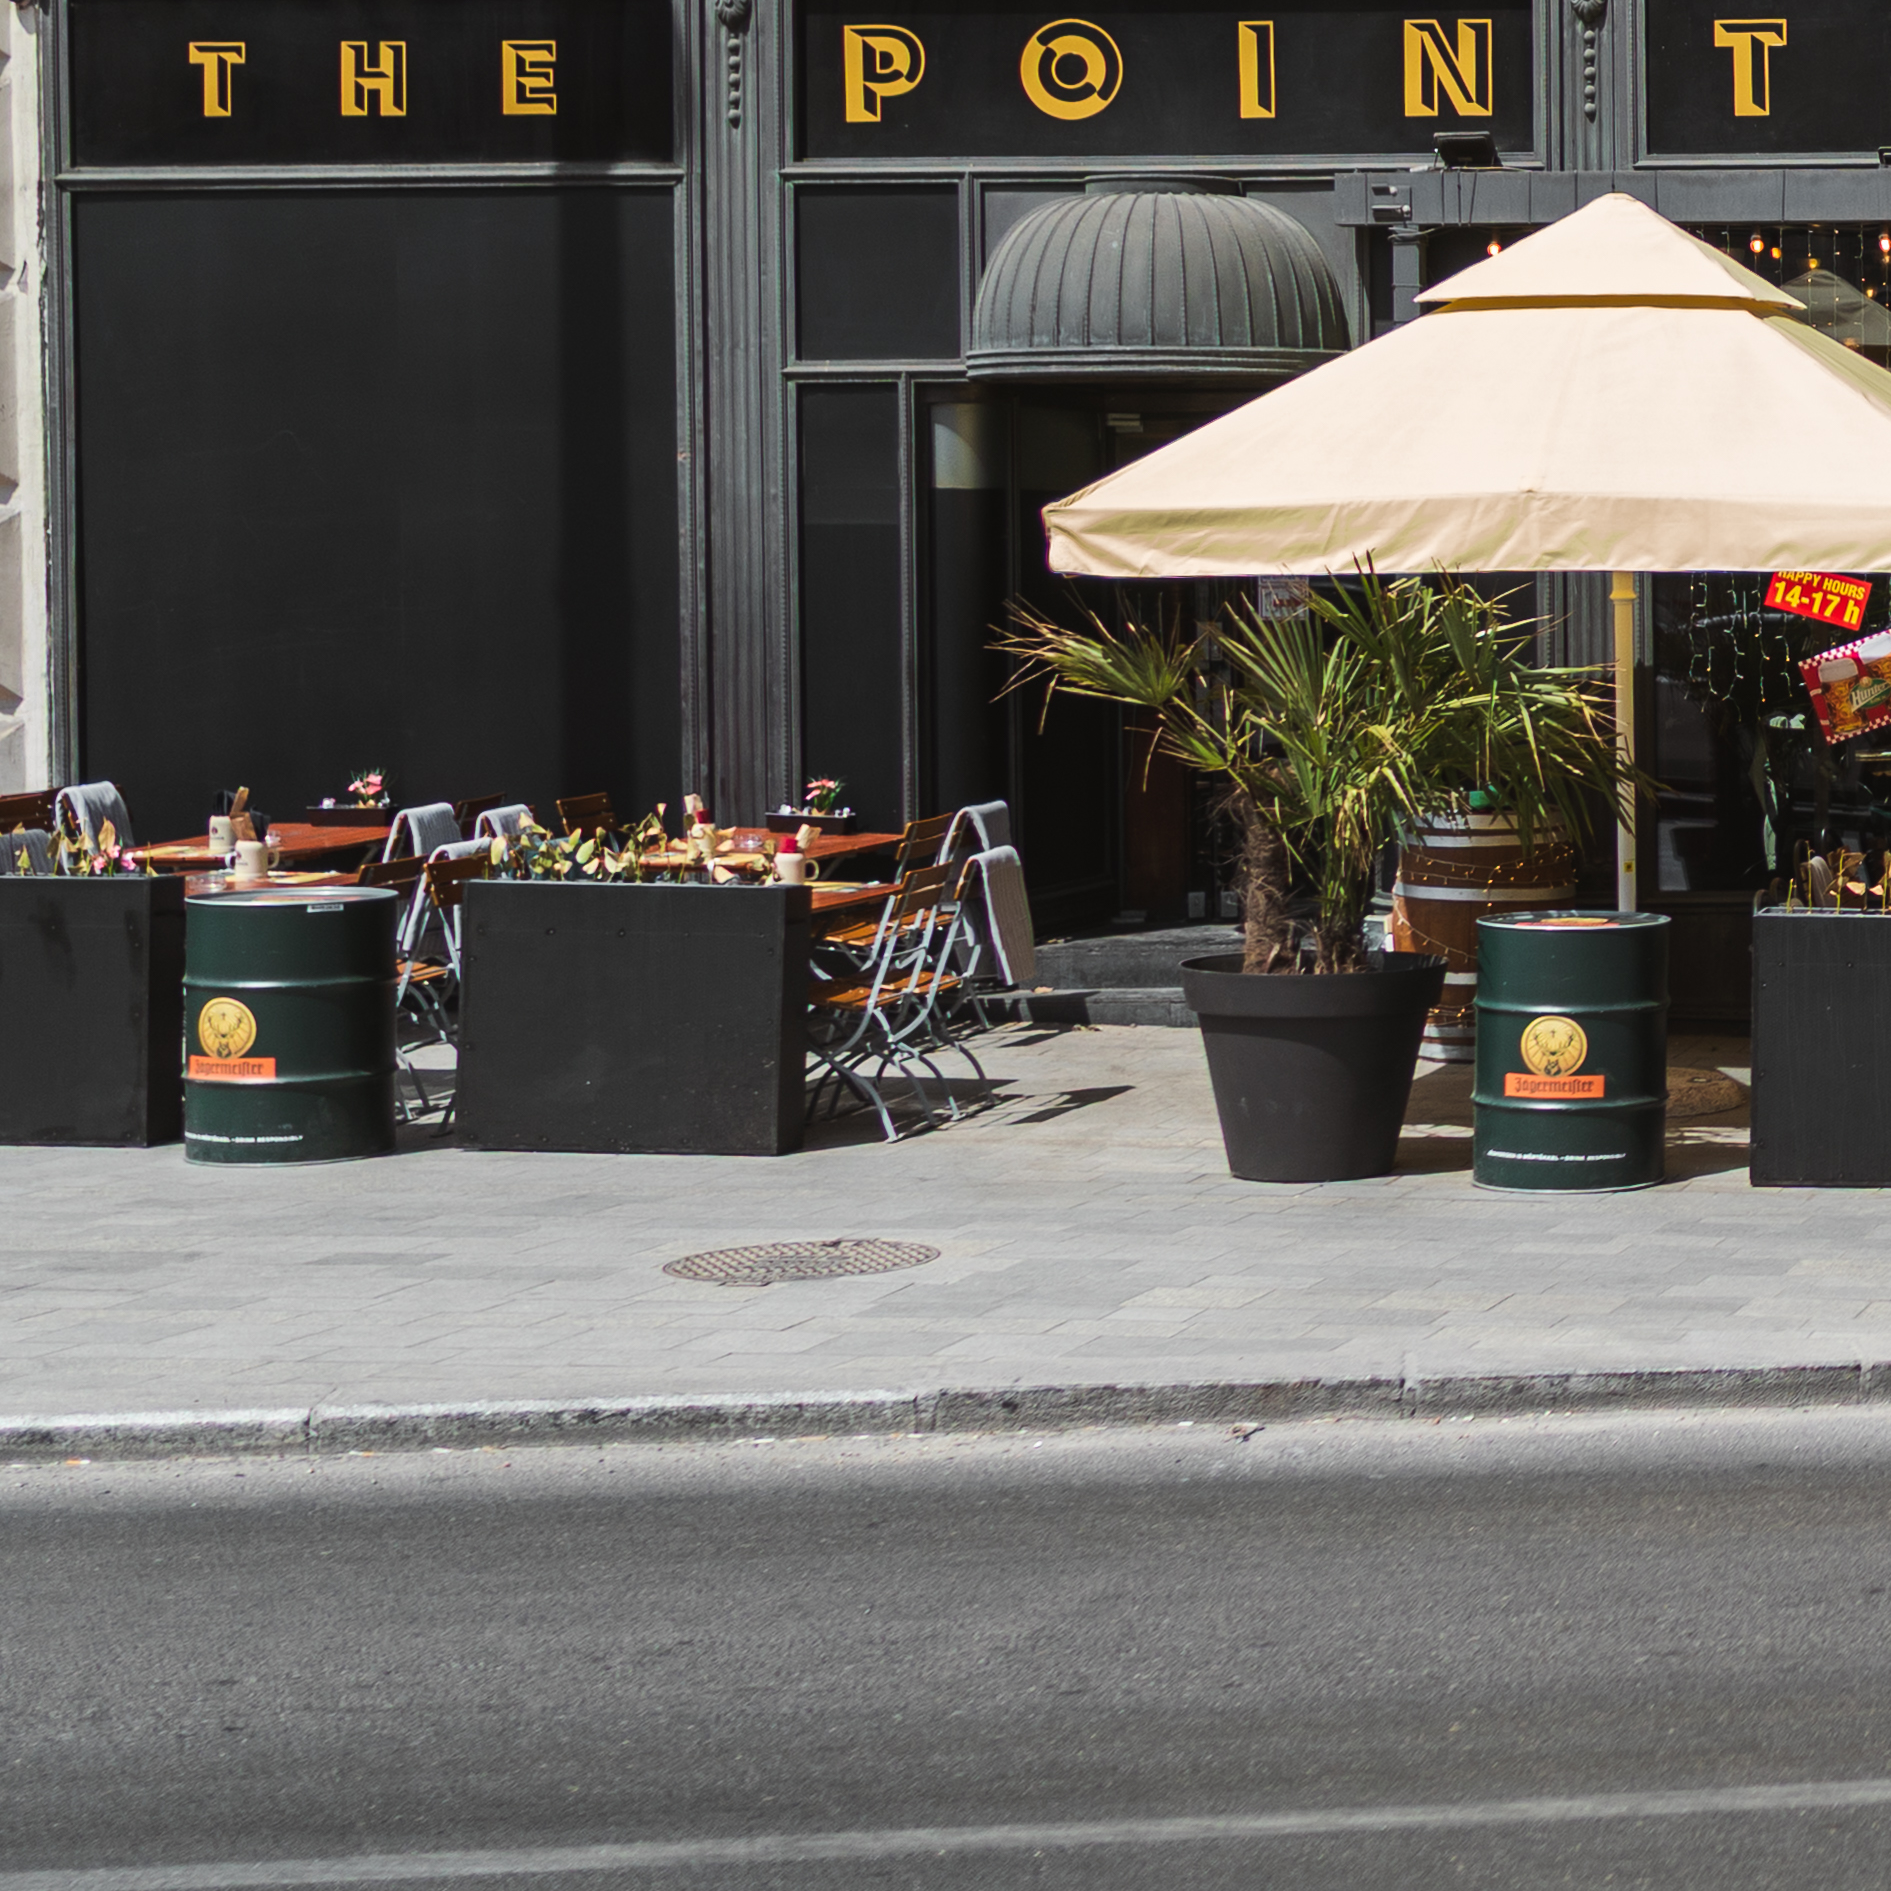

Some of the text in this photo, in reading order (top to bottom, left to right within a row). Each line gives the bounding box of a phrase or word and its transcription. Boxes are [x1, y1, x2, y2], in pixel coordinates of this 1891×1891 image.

[188, 39, 557, 117] THE
[1774, 580, 1861, 625] 14-17 h
[1778, 571, 1866, 600] HAPPY HOURS
